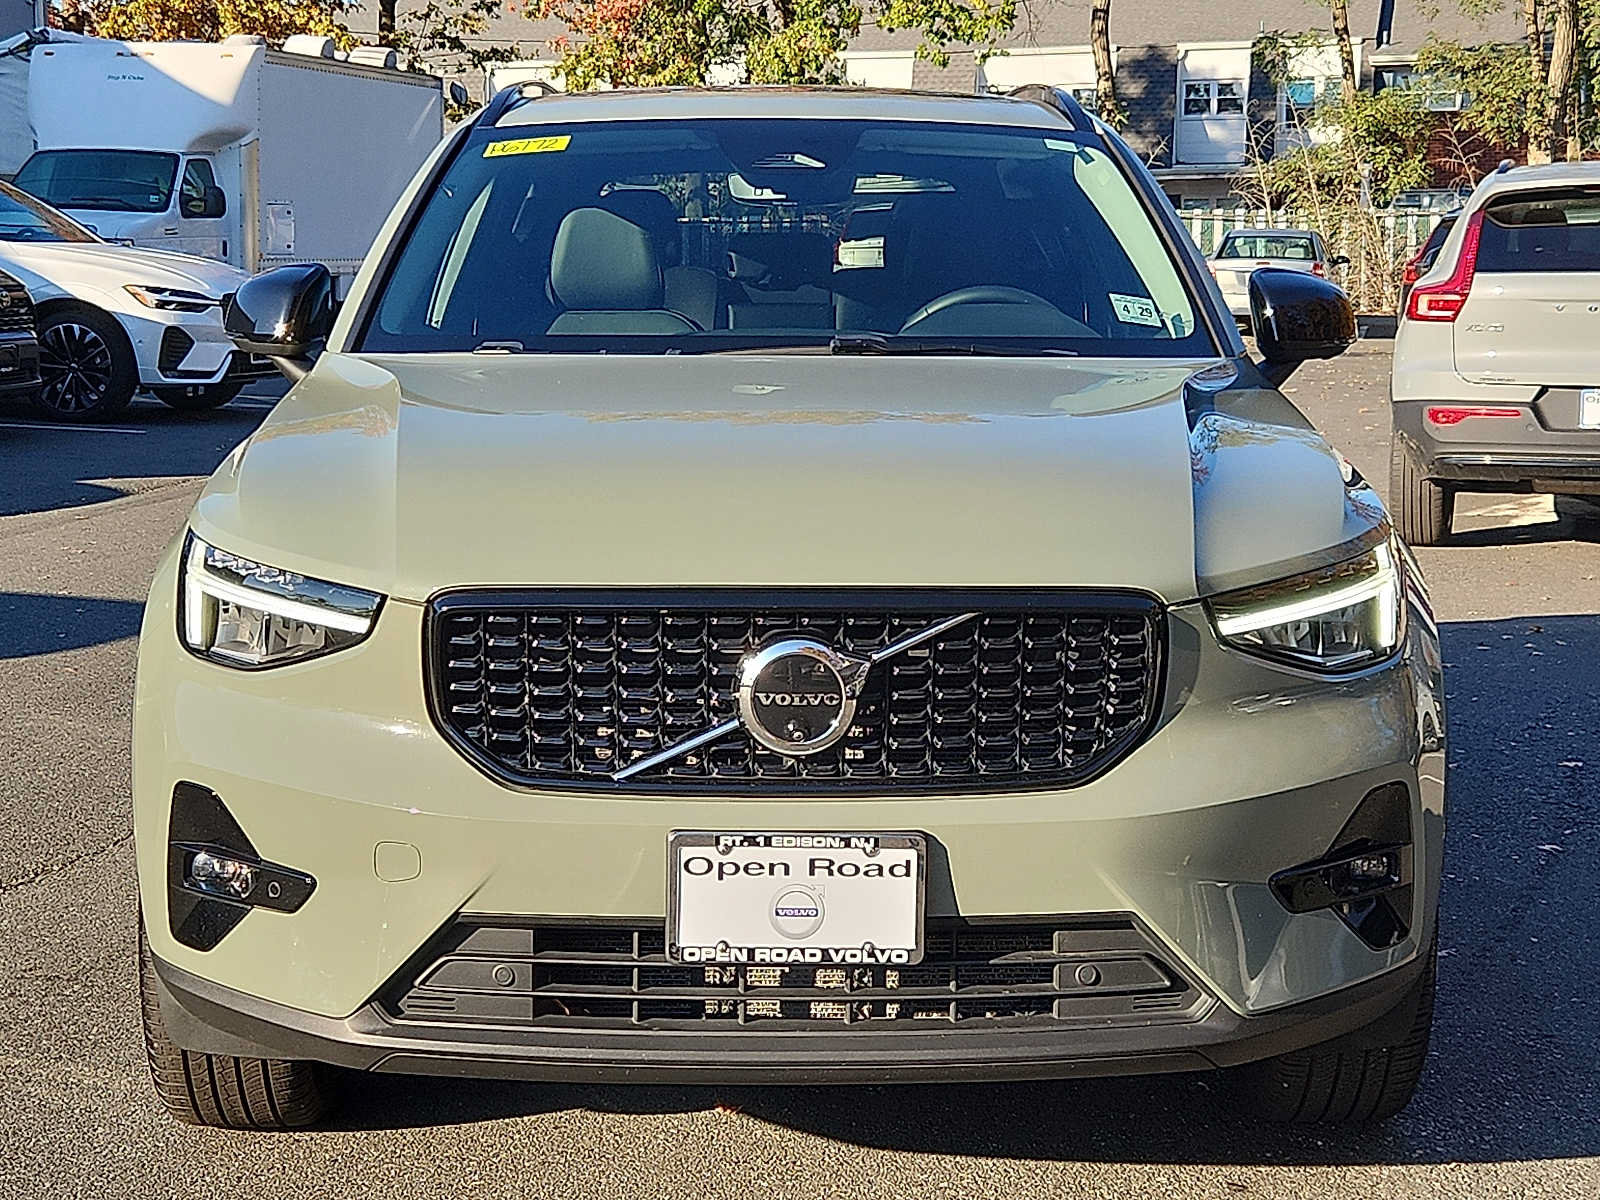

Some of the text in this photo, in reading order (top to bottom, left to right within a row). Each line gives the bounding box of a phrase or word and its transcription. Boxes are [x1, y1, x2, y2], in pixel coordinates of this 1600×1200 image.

[1122, 304, 1130, 315] 4
[1138, 306, 1153, 318] 29
[755, 692, 840, 706] VOLVO
[719, 835, 876, 850] RT. 1 EDISON, NJ
[683, 856, 912, 881] Open Road
[776, 908, 818, 917] VOLVO
[682, 948, 909, 963] OPEN ROAD VOLVO
